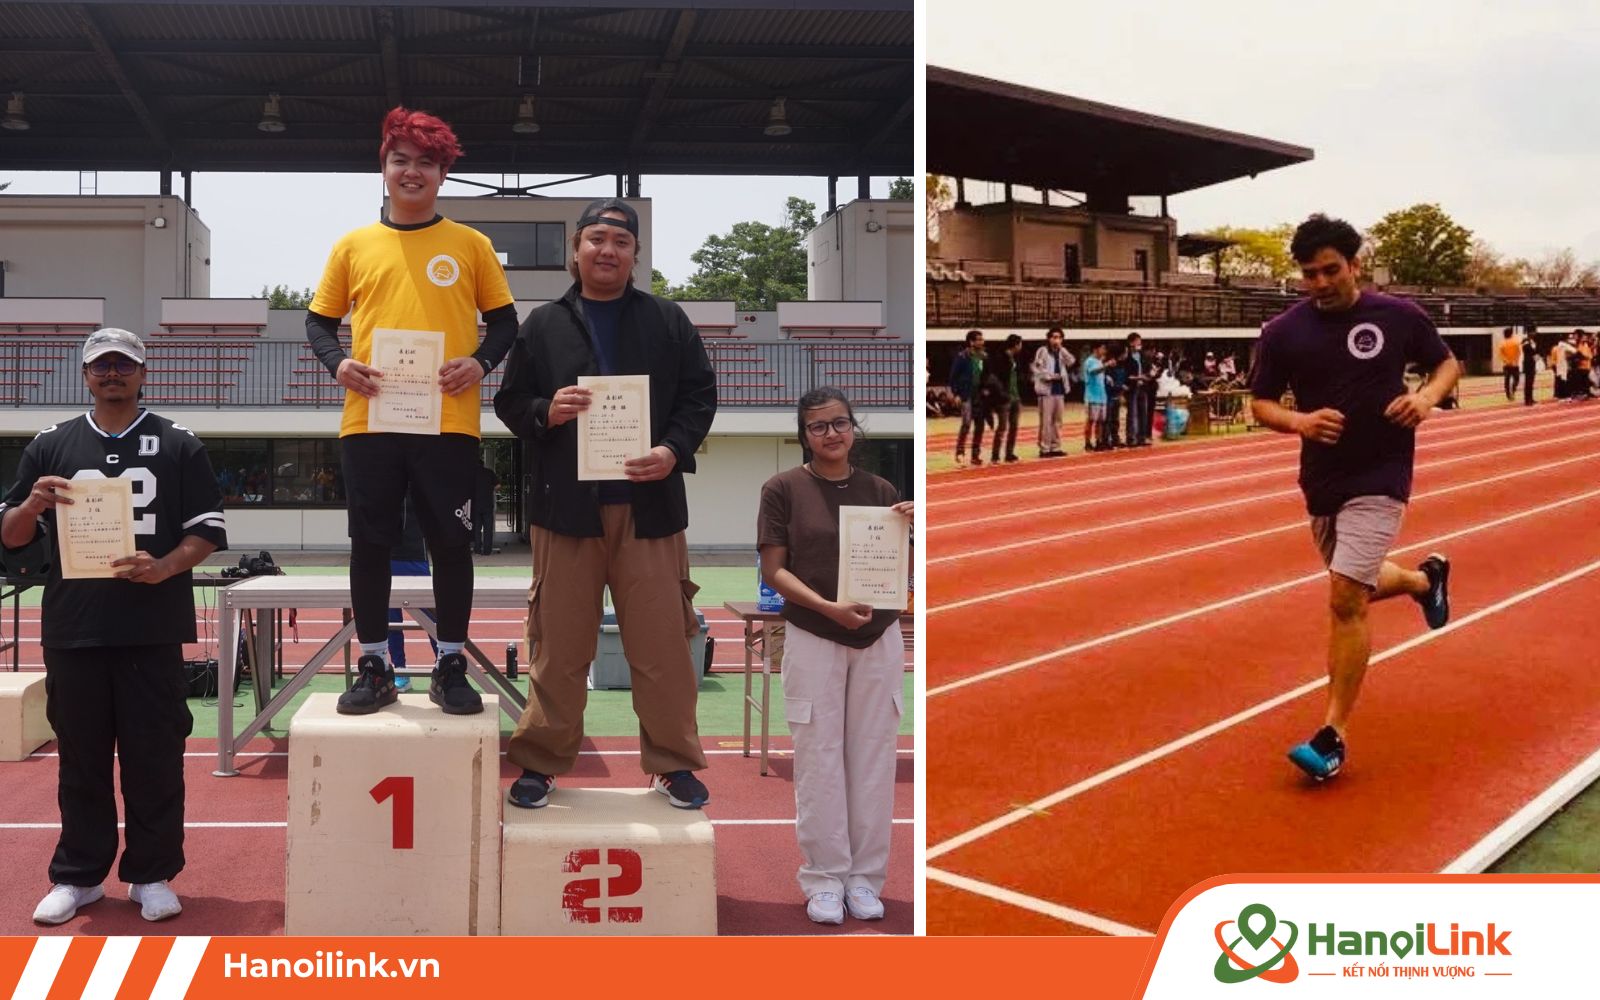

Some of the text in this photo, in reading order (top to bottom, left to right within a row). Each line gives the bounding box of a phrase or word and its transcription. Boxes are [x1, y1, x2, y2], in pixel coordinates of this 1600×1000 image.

[106, 454, 119, 464] C
[138, 435, 160, 456] D
[369, 777, 414, 850] 1
[561, 849, 644, 924] 2
